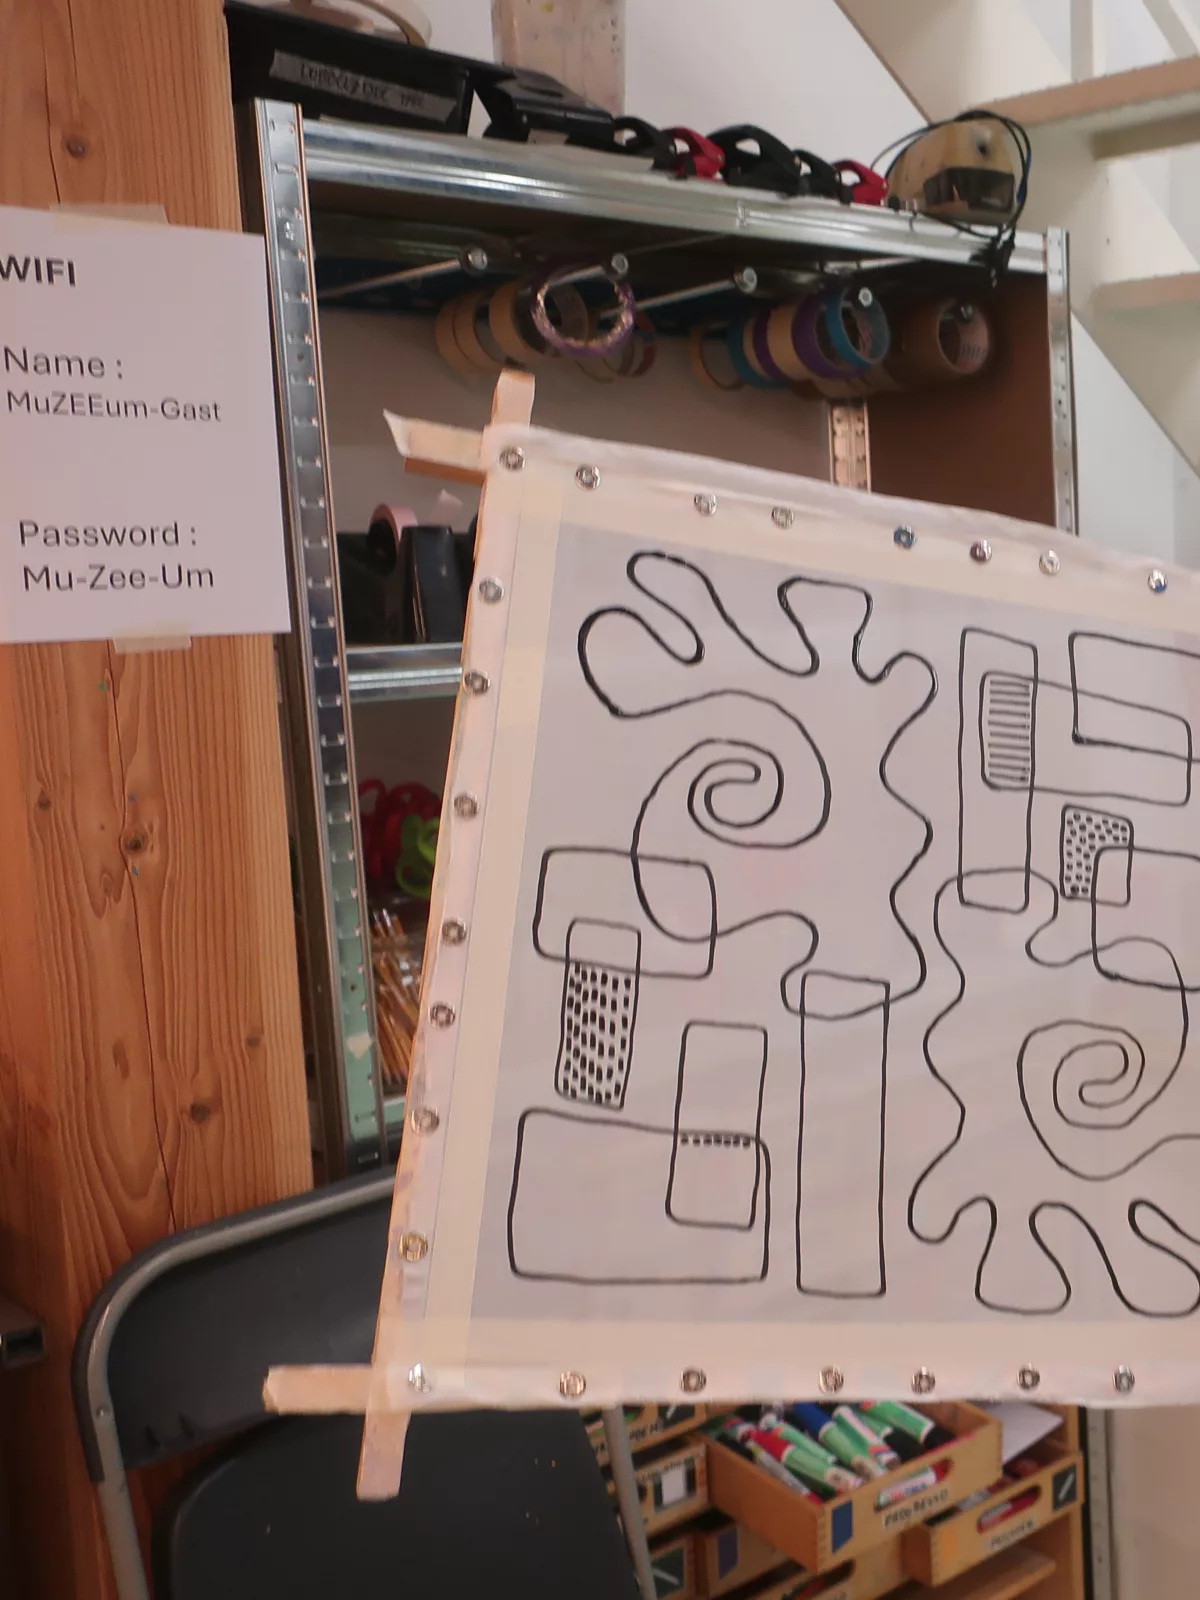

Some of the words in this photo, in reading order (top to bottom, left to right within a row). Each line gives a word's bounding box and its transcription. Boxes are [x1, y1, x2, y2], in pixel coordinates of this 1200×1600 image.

[0, 254, 76, 287] WIFI
[3, 345, 105, 379] Name
[7, 389, 221, 422] MuZEEum-Gast
[19, 519, 179, 548] Password
[23, 562, 214, 592] Mu-Zee-Um
